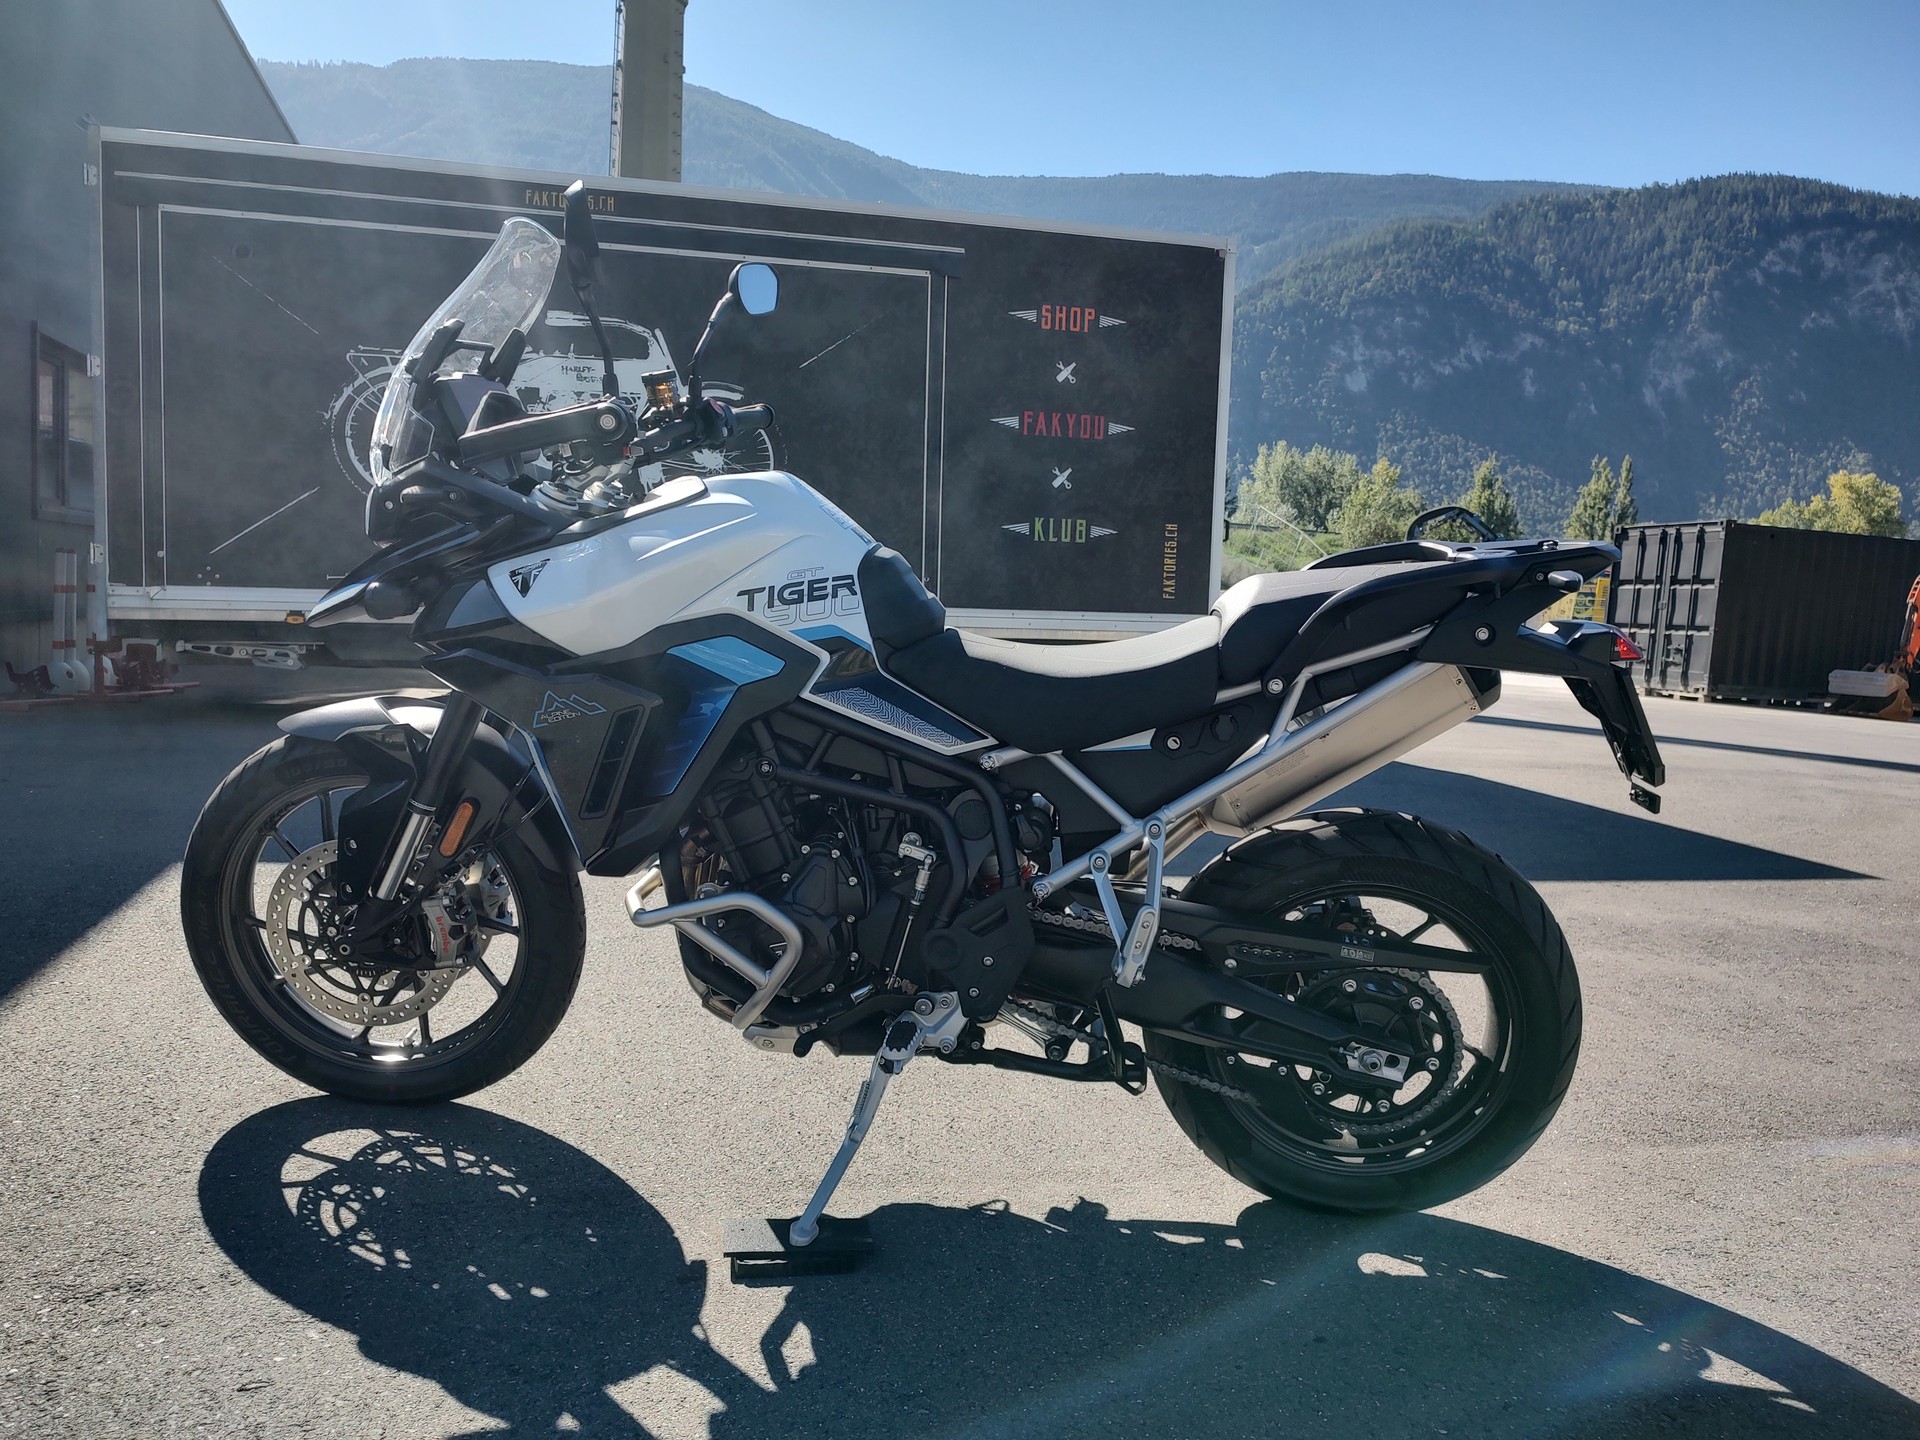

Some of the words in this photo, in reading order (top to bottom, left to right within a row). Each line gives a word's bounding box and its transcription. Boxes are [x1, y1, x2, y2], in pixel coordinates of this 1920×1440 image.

[525, 189, 615, 212] FAKTOS.CH
[1041, 305, 1096, 332] SHOP
[1022, 410, 1105, 440] FAKYOU
[1033, 517, 1087, 543] KLUB
[786, 566, 825, 580] GT
[1162, 523, 1178, 599] FAKTORIES.CH
[736, 574, 858, 612] TIGER
[435, 914, 451, 953] brembo
